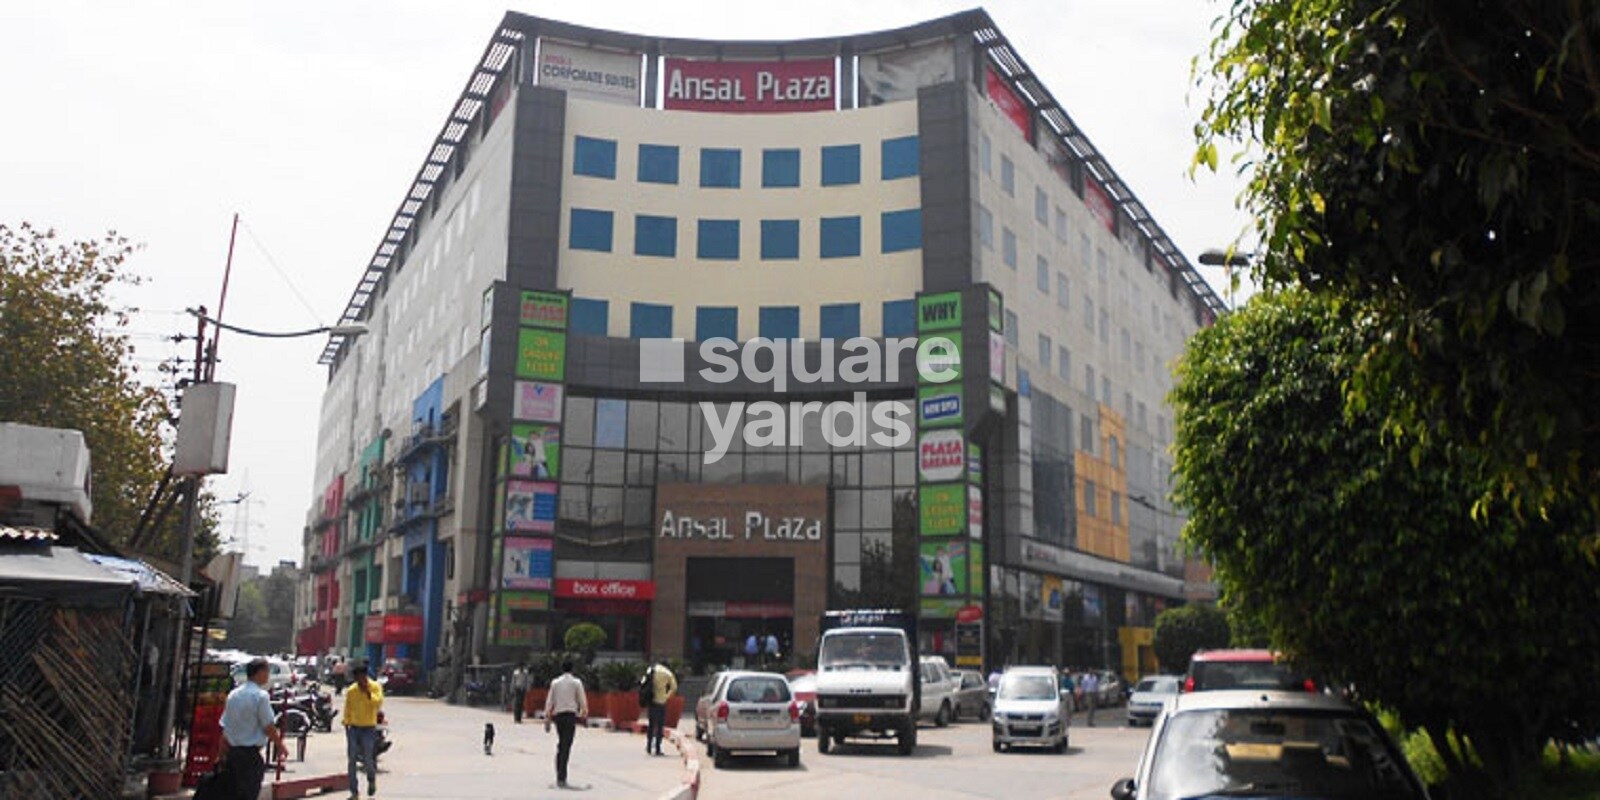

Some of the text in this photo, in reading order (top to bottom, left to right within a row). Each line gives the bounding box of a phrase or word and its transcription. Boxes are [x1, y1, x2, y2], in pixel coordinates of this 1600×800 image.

[543, 64, 604, 84] CORPORATE
[668, 69, 832, 101] Ansal Plaza
[922, 300, 958, 323] WHY
[922, 441, 961, 456] PLAZA
[660, 509, 822, 541] Ansal Plaza
[572, 580, 636, 596] box office
